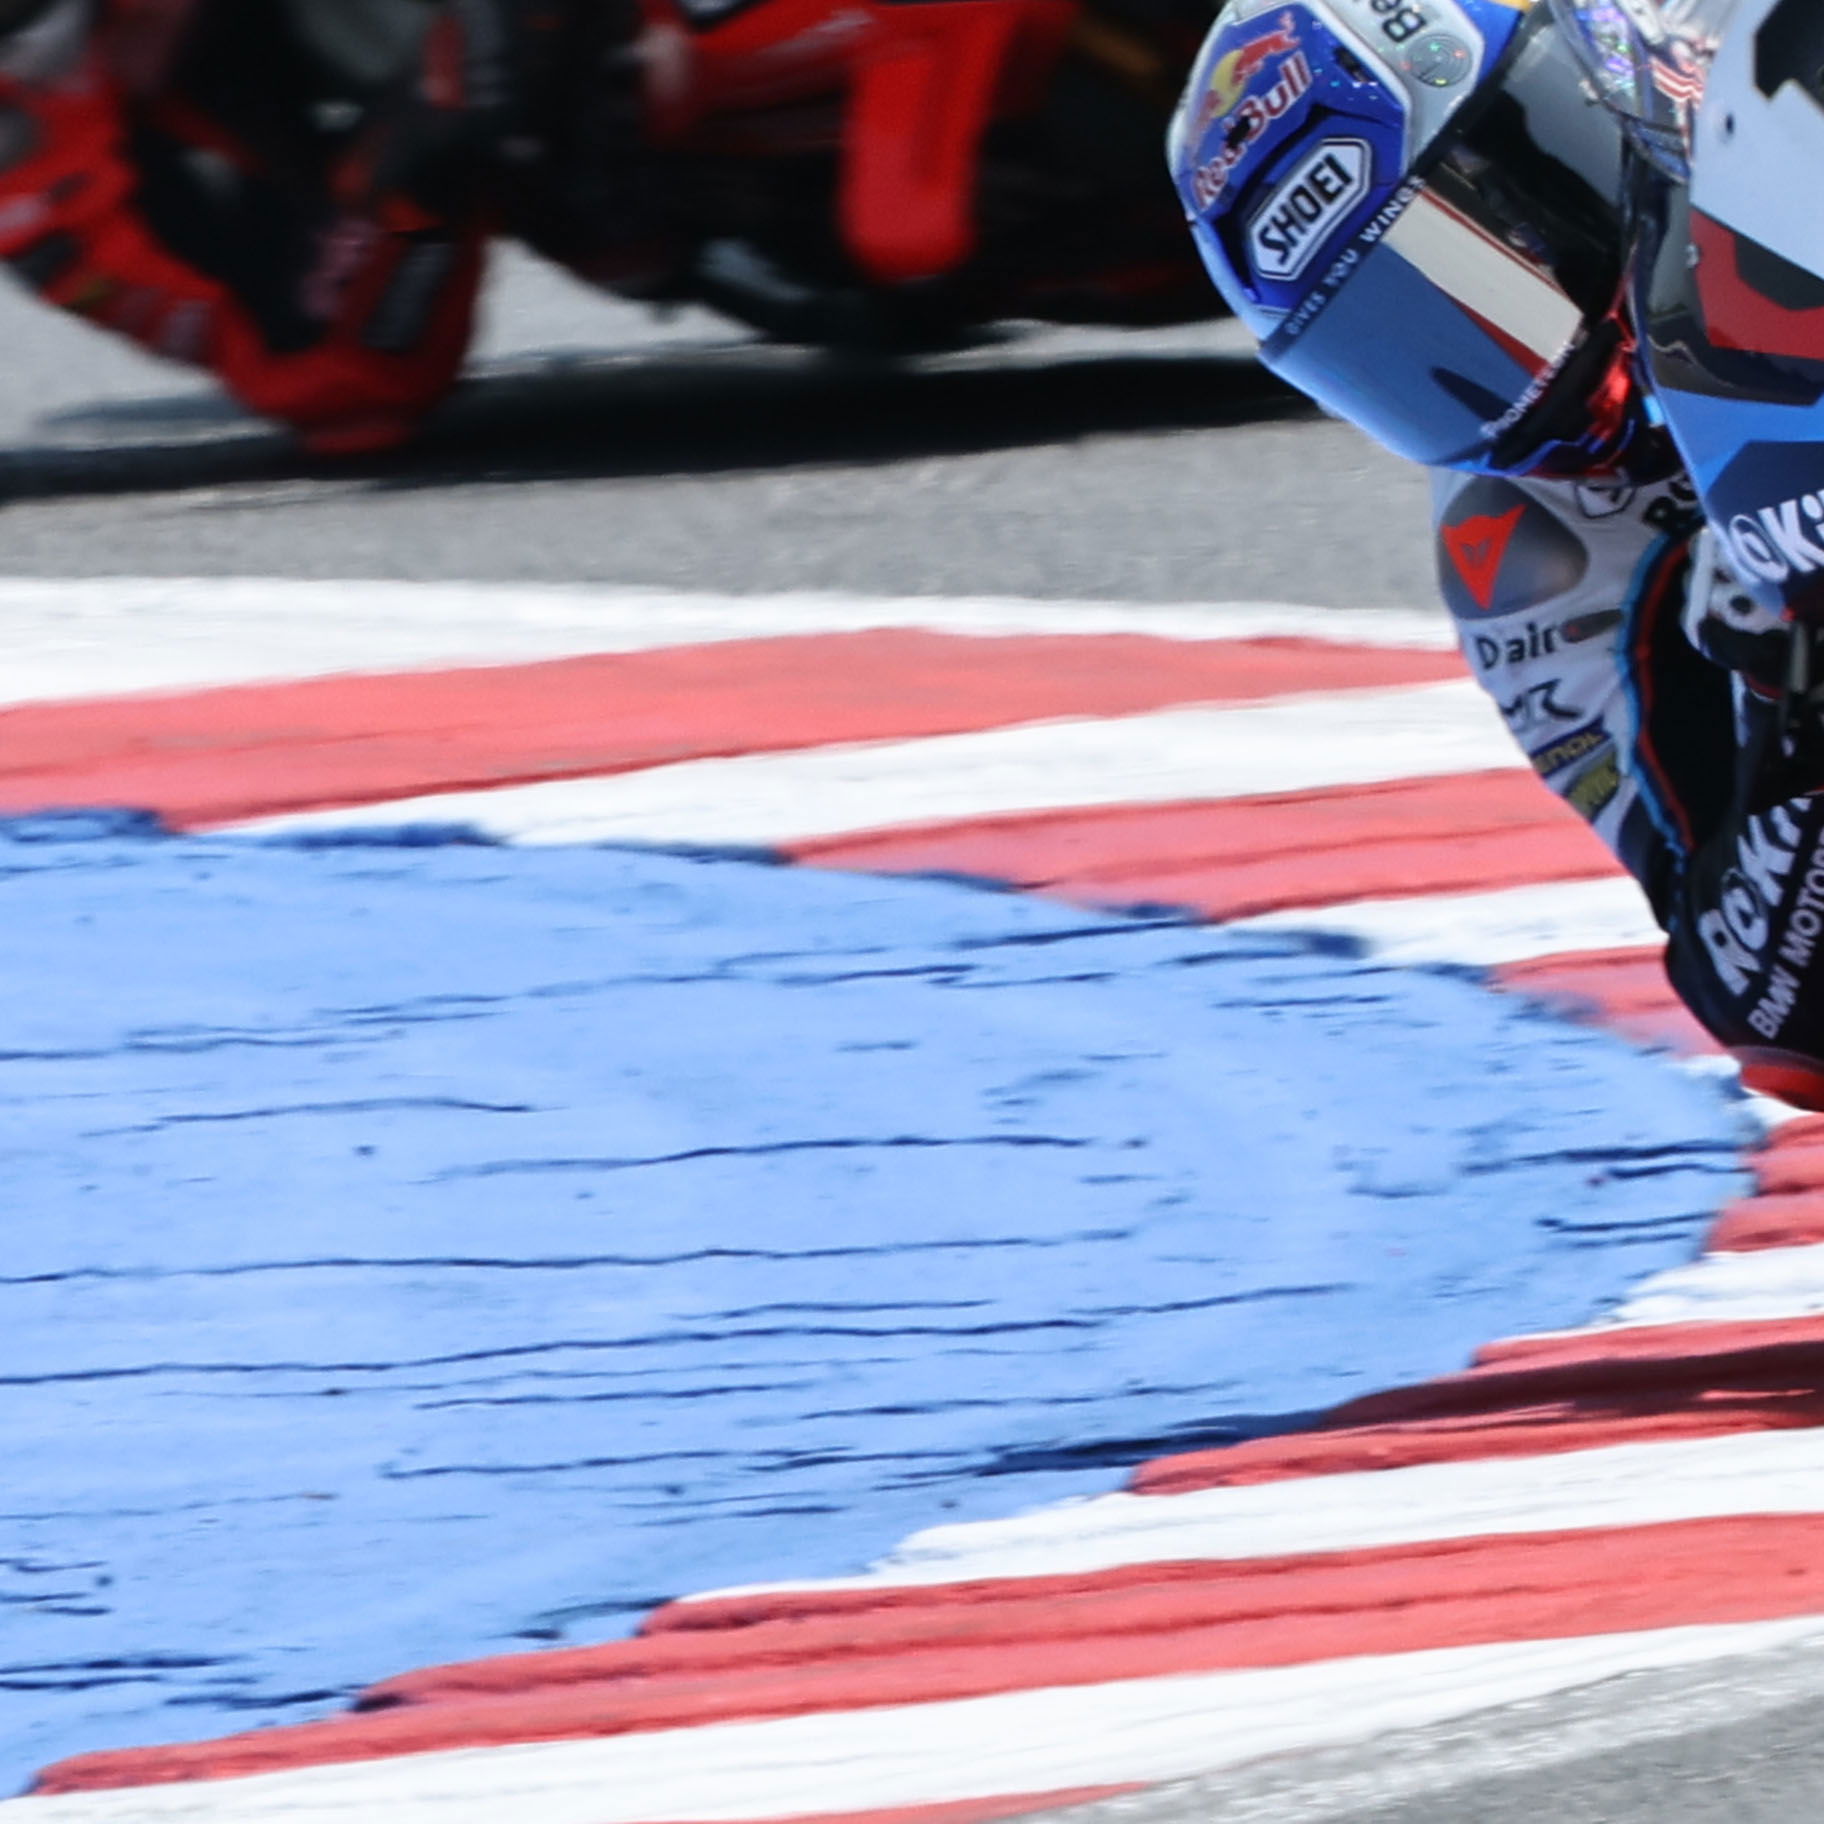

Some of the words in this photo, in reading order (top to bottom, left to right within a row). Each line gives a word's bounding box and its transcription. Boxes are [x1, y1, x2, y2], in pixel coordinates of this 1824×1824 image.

[1190, 118, 1250, 211] Red
[1235, 50, 1314, 142] Bull
[1258, 154, 1354, 266] SHOEI
[1286, 293, 1326, 335] GIVES
[1321, 249, 1358, 288] YOU
[1360, 175, 1426, 244] WINGS
[1747, 963, 1800, 1040] BMW
